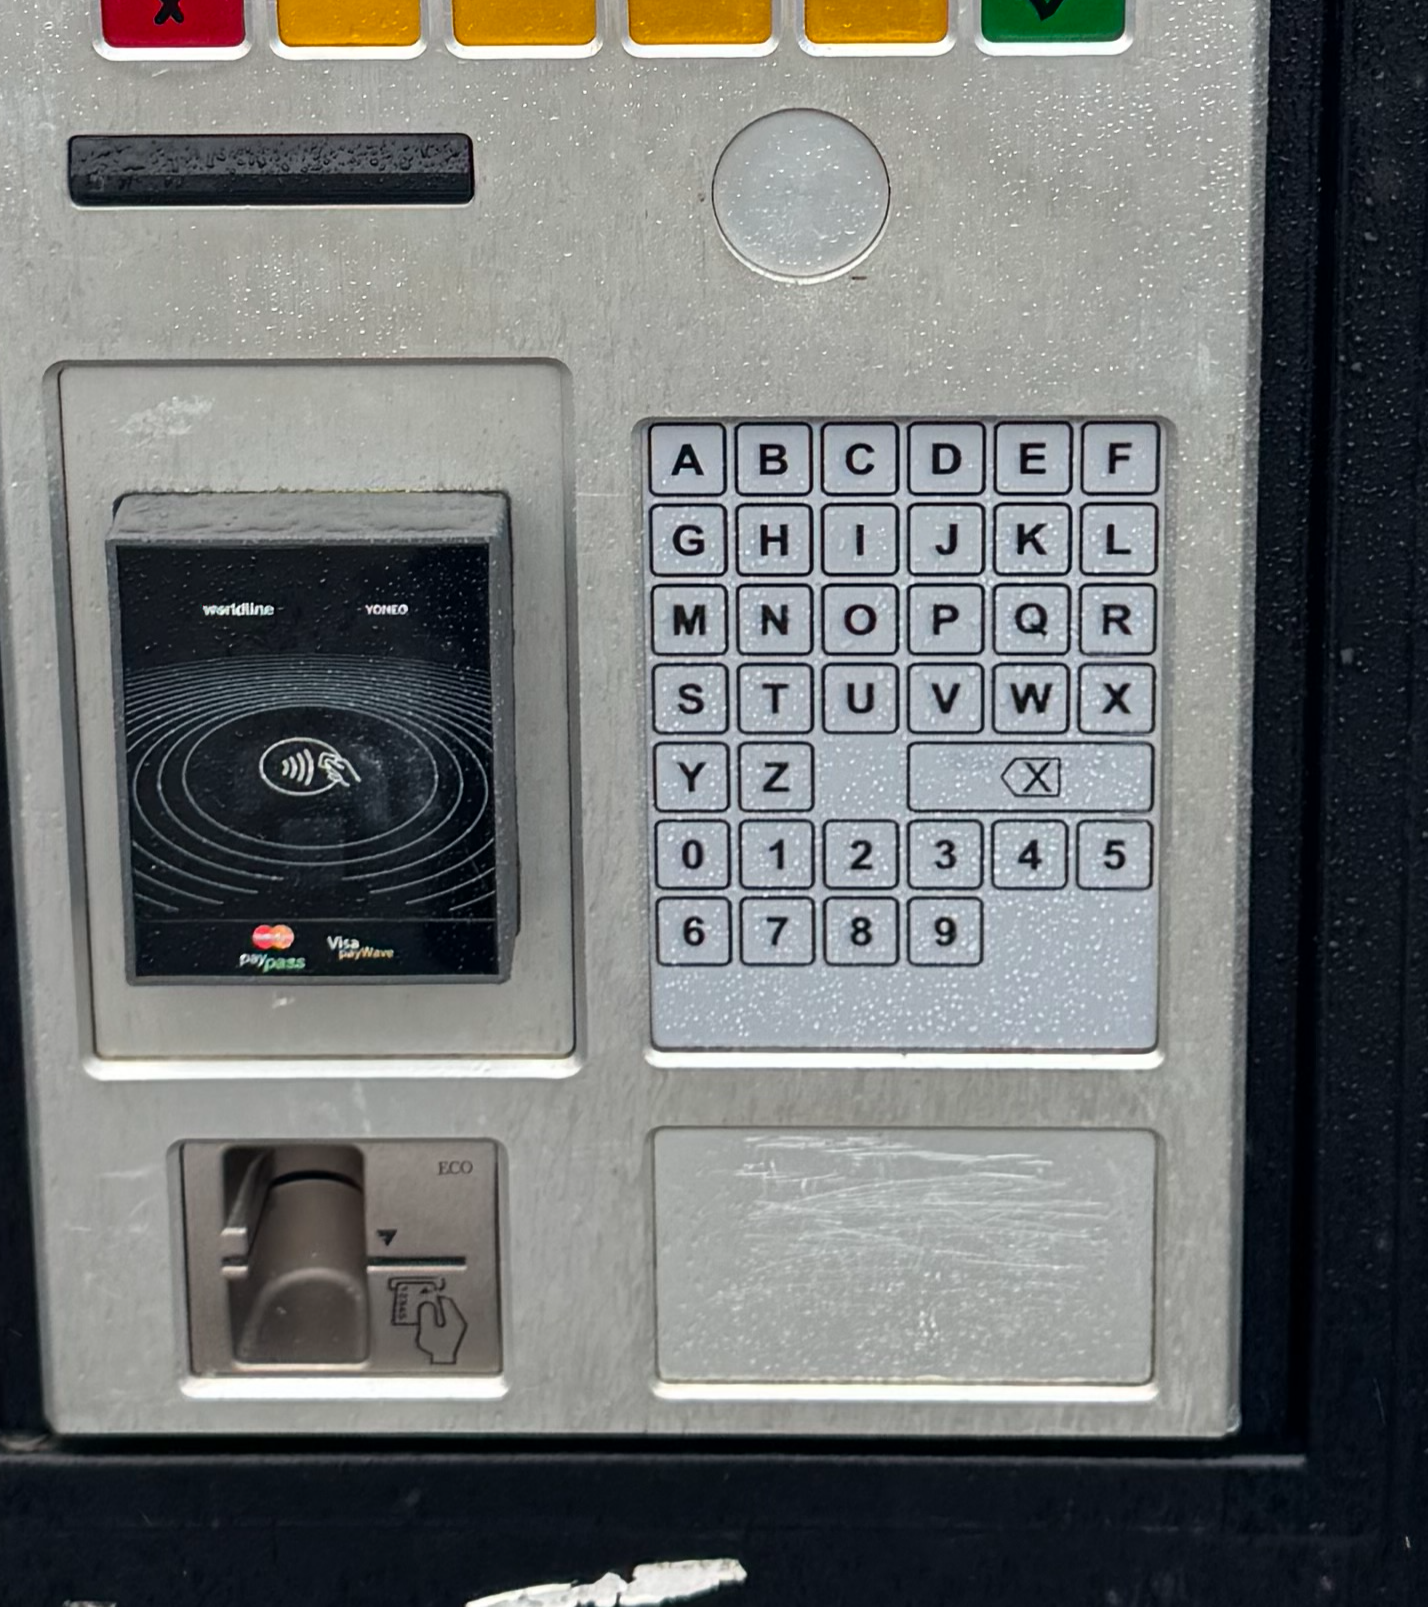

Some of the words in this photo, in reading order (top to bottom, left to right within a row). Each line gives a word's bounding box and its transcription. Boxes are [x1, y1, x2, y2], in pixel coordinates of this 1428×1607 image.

[671, 443, 704, 475] A
[759, 443, 788, 475] B
[845, 443, 875, 475] C
[932, 443, 961, 475] D
[1020, 443, 1046, 475] E
[1108, 443, 1132, 475] F
[672, 524, 705, 556] G
[760, 524, 788, 556] H
[856, 524, 864, 556] I
[935, 524, 957, 556] J
[1017, 524, 1047, 556] K
[1106, 524, 1131, 556] L
[202, 602, 274, 616] worldline
[673, 604, 705, 636] M
[761, 604, 788, 636] N
[844, 604, 876, 636] O
[933, 604, 959, 636] P
[1015, 604, 1047, 636] Q
[1102, 604, 1132, 636] R
[678, 683, 704, 714] S
[762, 683, 788, 714] T
[848, 683, 872, 714] U
[932, 683, 960, 714] V
[1010, 683, 1052, 714] W
[1102, 683, 1131, 714] X
[679, 762, 705, 793] Y
[763, 762, 789, 793] Z
[681, 840, 703, 870] 0
[768, 840, 784, 870] 1
[850, 840, 872, 870] 2
[935, 840, 957, 870] 3
[1018, 840, 1042, 870] 4
[1104, 840, 1125, 870] 5
[327, 935, 360, 951] Visa
[683, 917, 705, 946] 6
[766, 917, 788, 946] 7
[850, 917, 872, 946] 8
[934, 917, 956, 946] 9
[438, 1161, 473, 1175] ECO
